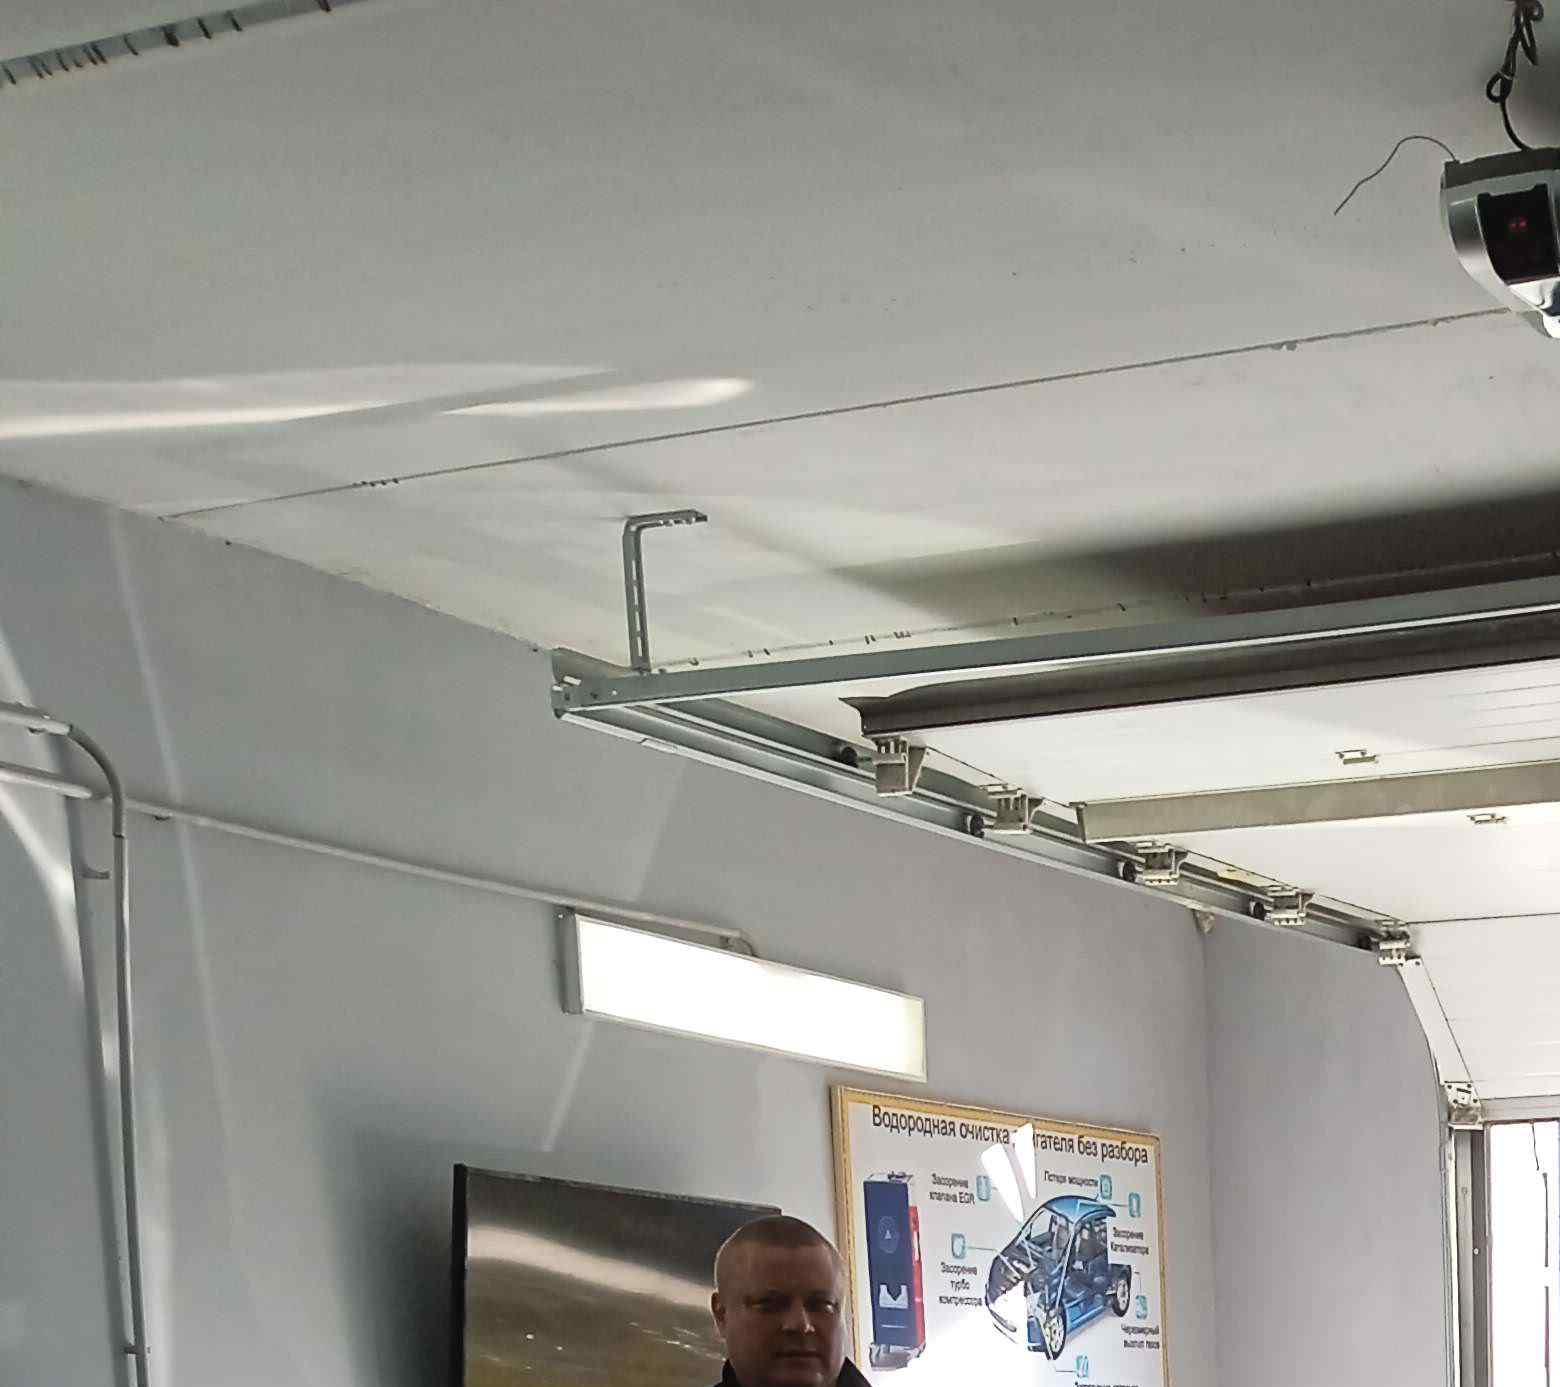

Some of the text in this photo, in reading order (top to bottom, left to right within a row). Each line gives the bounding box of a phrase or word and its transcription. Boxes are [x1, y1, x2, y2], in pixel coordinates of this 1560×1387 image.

[871, 1104, 956, 1138] Водородная
[959, 1120, 1010, 1144] очистка
[1077, 1134, 1098, 1157] без
[1100, 1140, 1149, 1164] разбора
